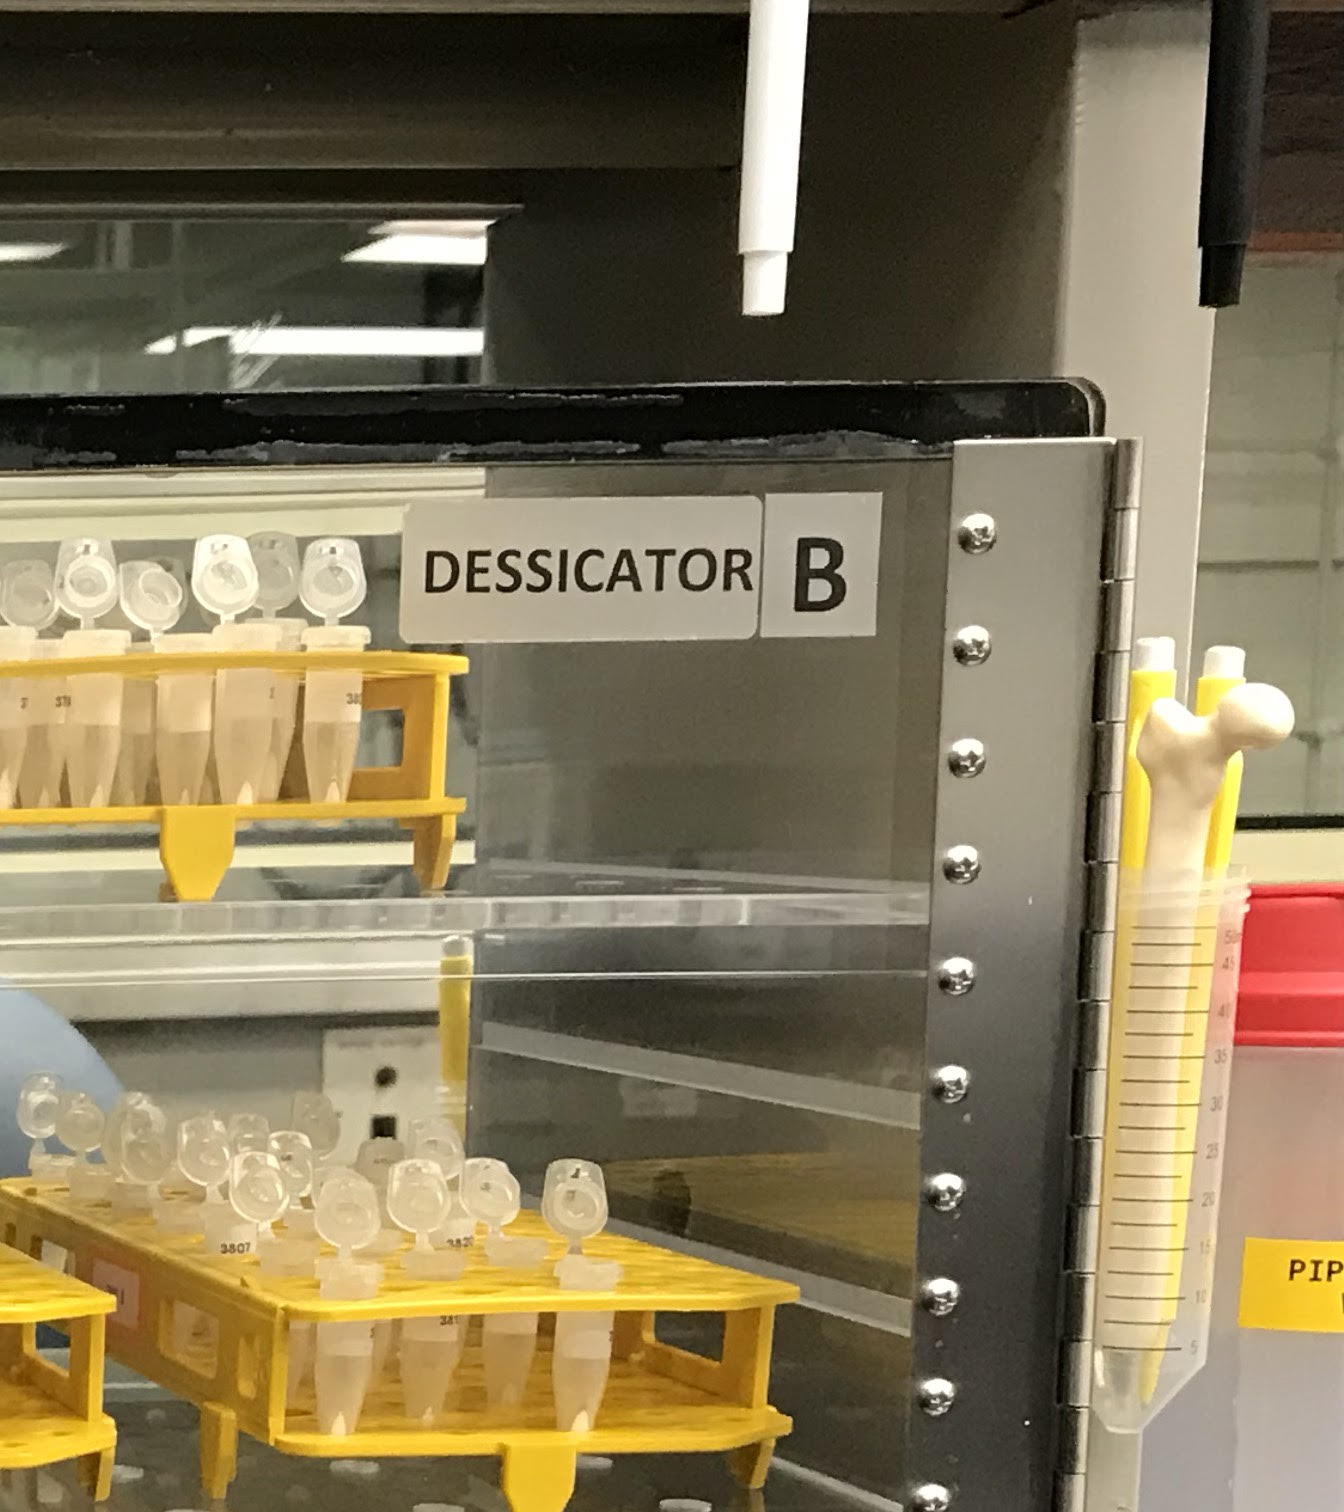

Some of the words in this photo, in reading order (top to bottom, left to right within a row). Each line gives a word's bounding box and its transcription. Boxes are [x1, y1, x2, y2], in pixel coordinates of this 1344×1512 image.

[424, 549, 754, 594] DESSICATOR
[794, 537, 848, 613] B
[1214, 1049, 1228, 1064] 35
[1210, 1096, 1224, 1112] 30
[1205, 1143, 1220, 1159] 25
[1201, 1191, 1216, 1207] 20
[220, 1242, 251, 1254] 3807
